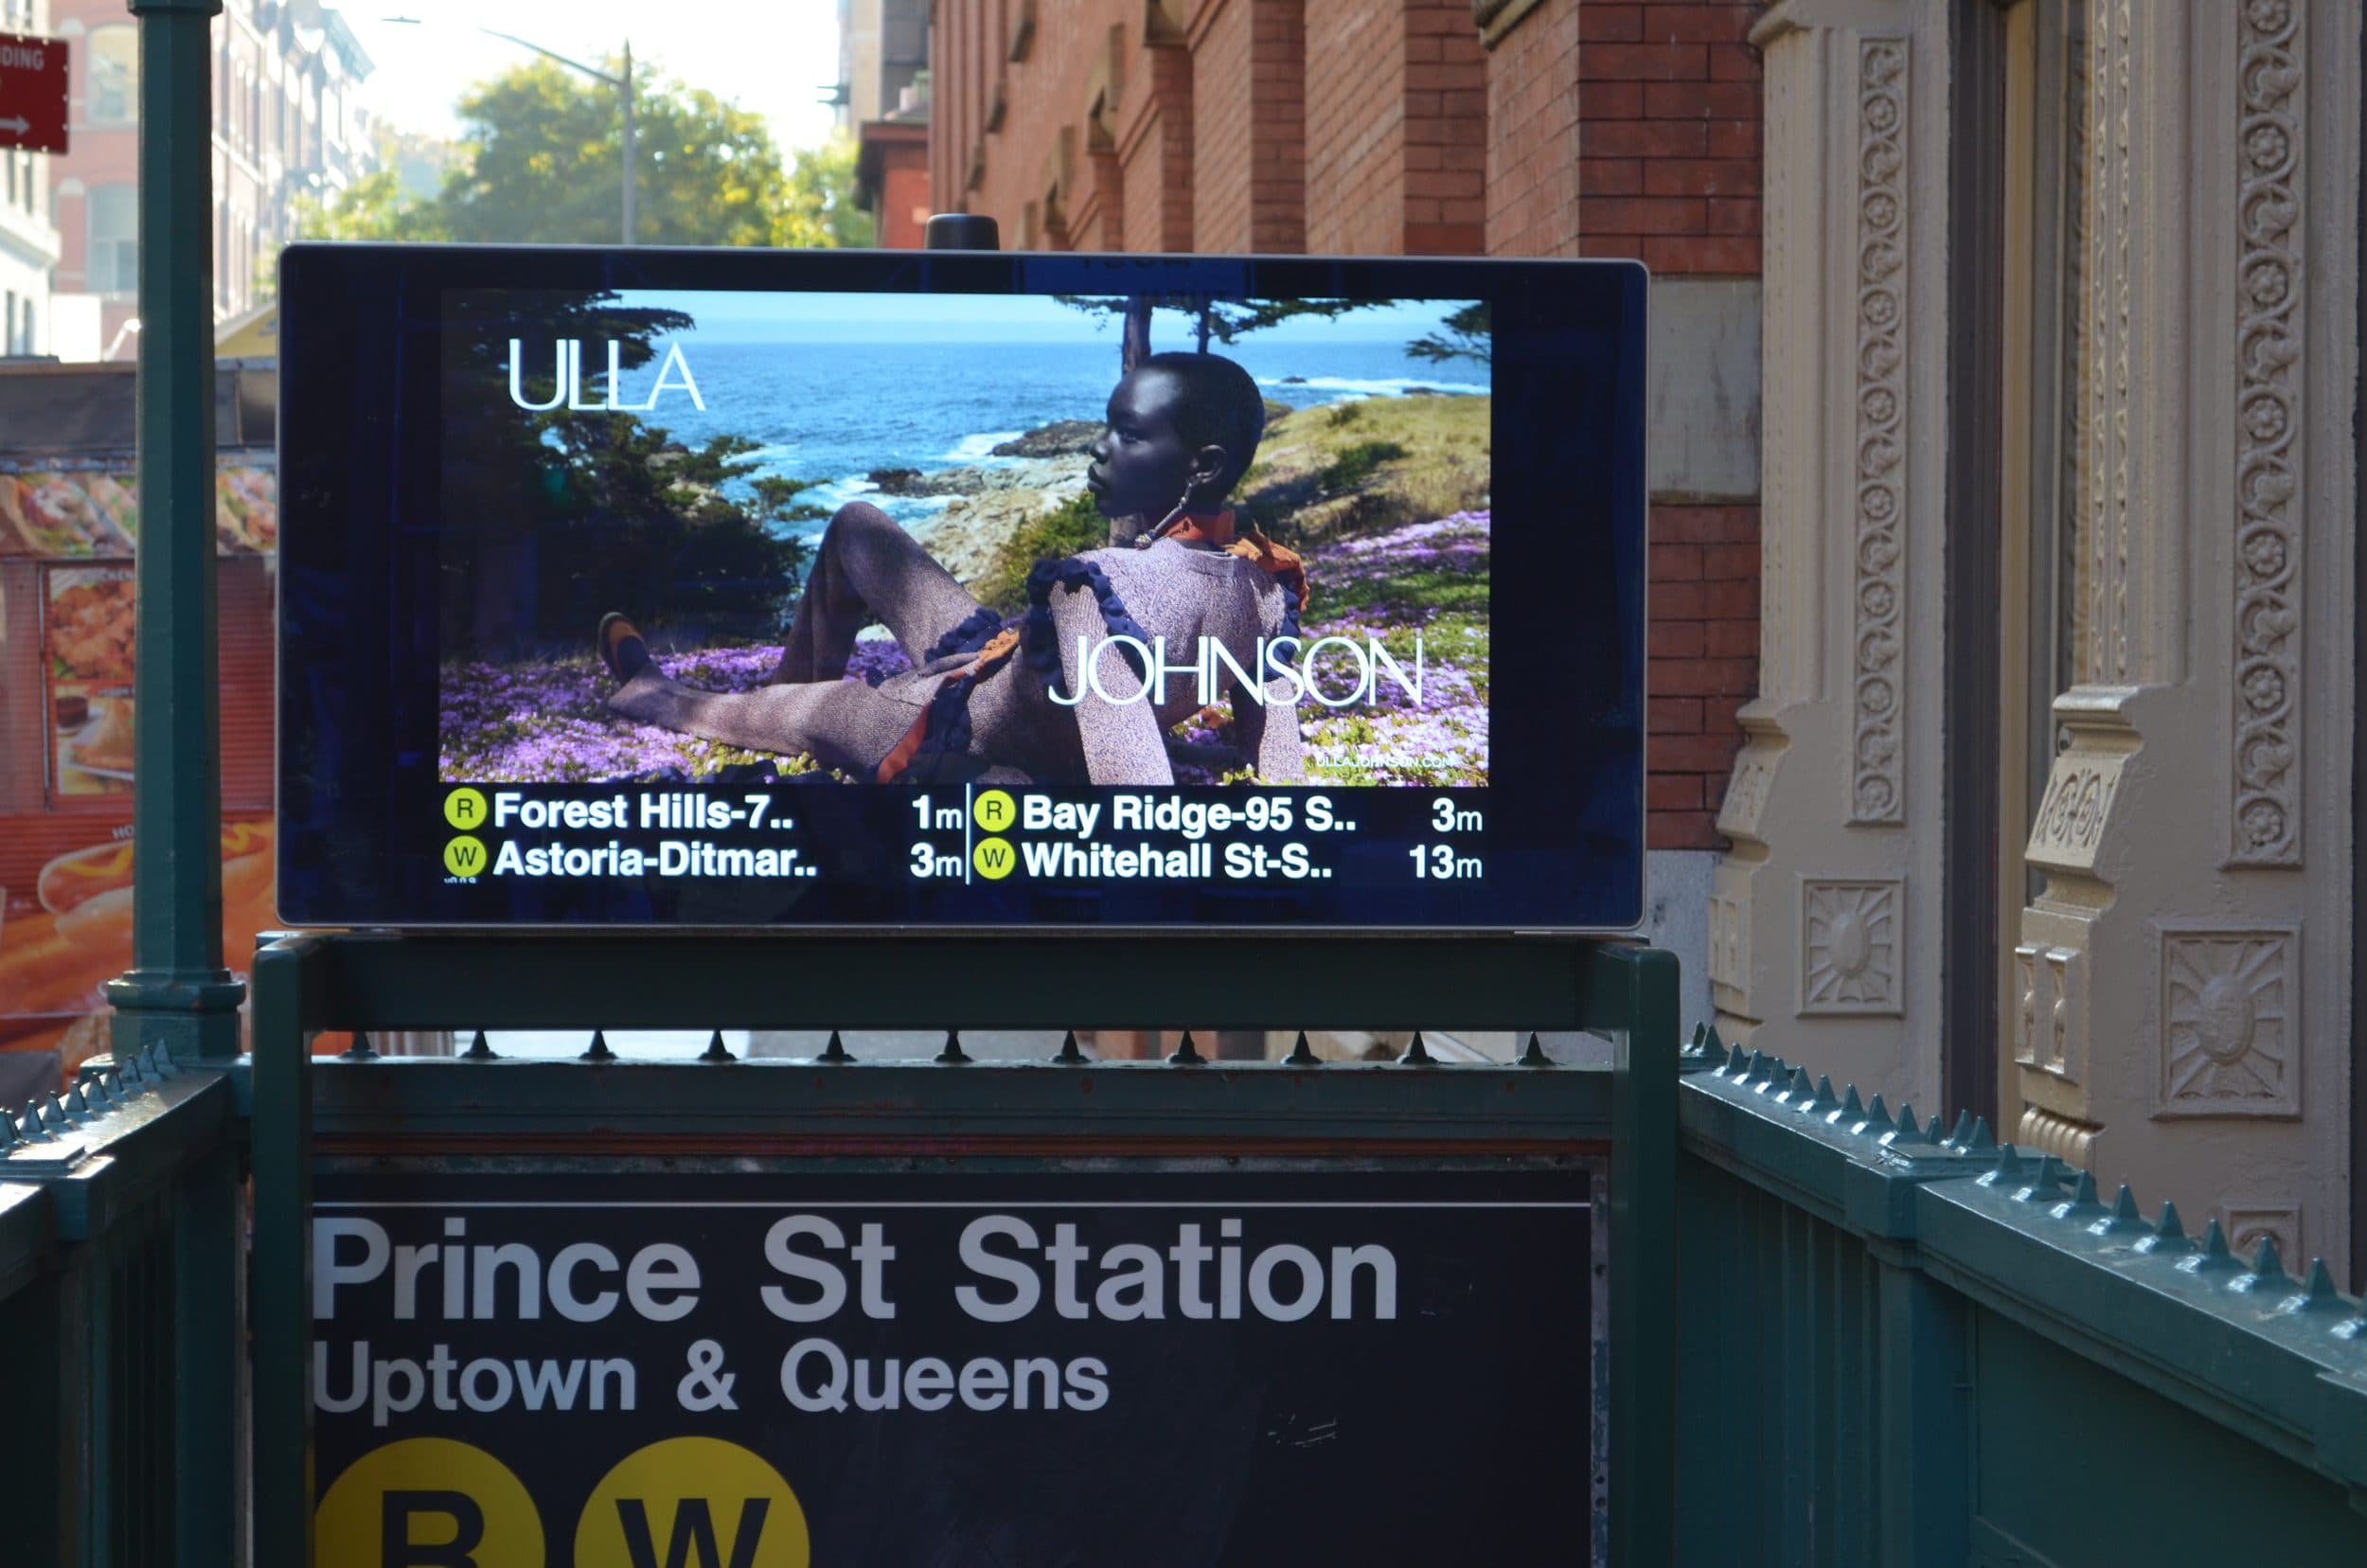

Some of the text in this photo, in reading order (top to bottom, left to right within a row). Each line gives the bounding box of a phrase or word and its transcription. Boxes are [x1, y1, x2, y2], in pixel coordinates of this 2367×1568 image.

[0, 45, 45, 71] DING
[508, 338, 706, 411] ULLA
[1048, 635, 1423, 706] JOHNSON
[493, 793, 629, 829] Forest
[640, 793, 793, 829] Hills-7..
[1023, 794, 1101, 840] Bay
[1112, 794, 1293, 840] Ridge-95
[1305, 795, 1357, 831] S..
[492, 840, 817, 877] Astoria-Ditmar..
[1021, 842, 1212, 878] Whitehall
[1224, 842, 1333, 879] St-S..
[311, 1214, 1397, 1323] Prince St Station
[312, 1337, 1111, 1427] Uptown & Queens
[614, 1497, 773, 1568] W
